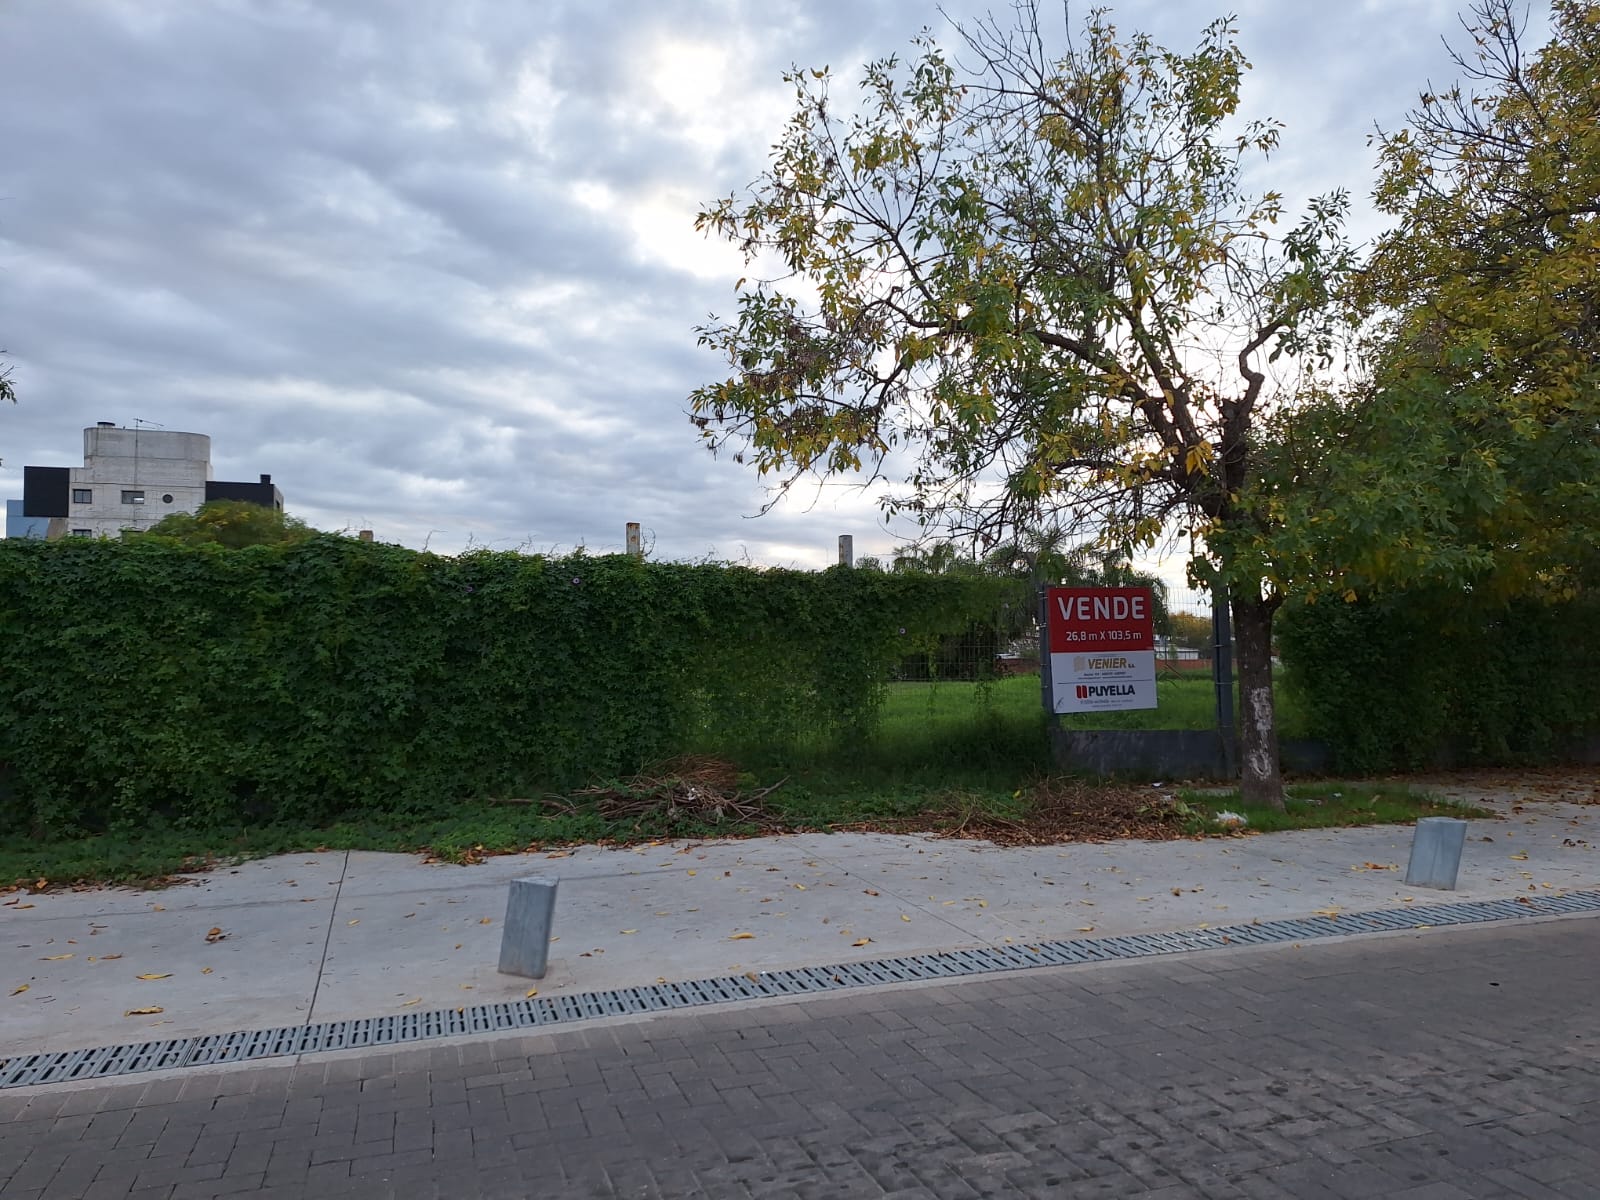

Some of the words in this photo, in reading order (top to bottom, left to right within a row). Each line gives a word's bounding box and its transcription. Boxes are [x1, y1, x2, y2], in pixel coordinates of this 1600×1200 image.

[1057, 596, 1145, 620] VENDE
[1088, 633, 1098, 641] m
[1108, 630, 1131, 640] 103,5
[1133, 631, 1142, 639] m
[1088, 658, 1127, 669] VENIER
[1088, 685, 1135, 697] PUYELLA
